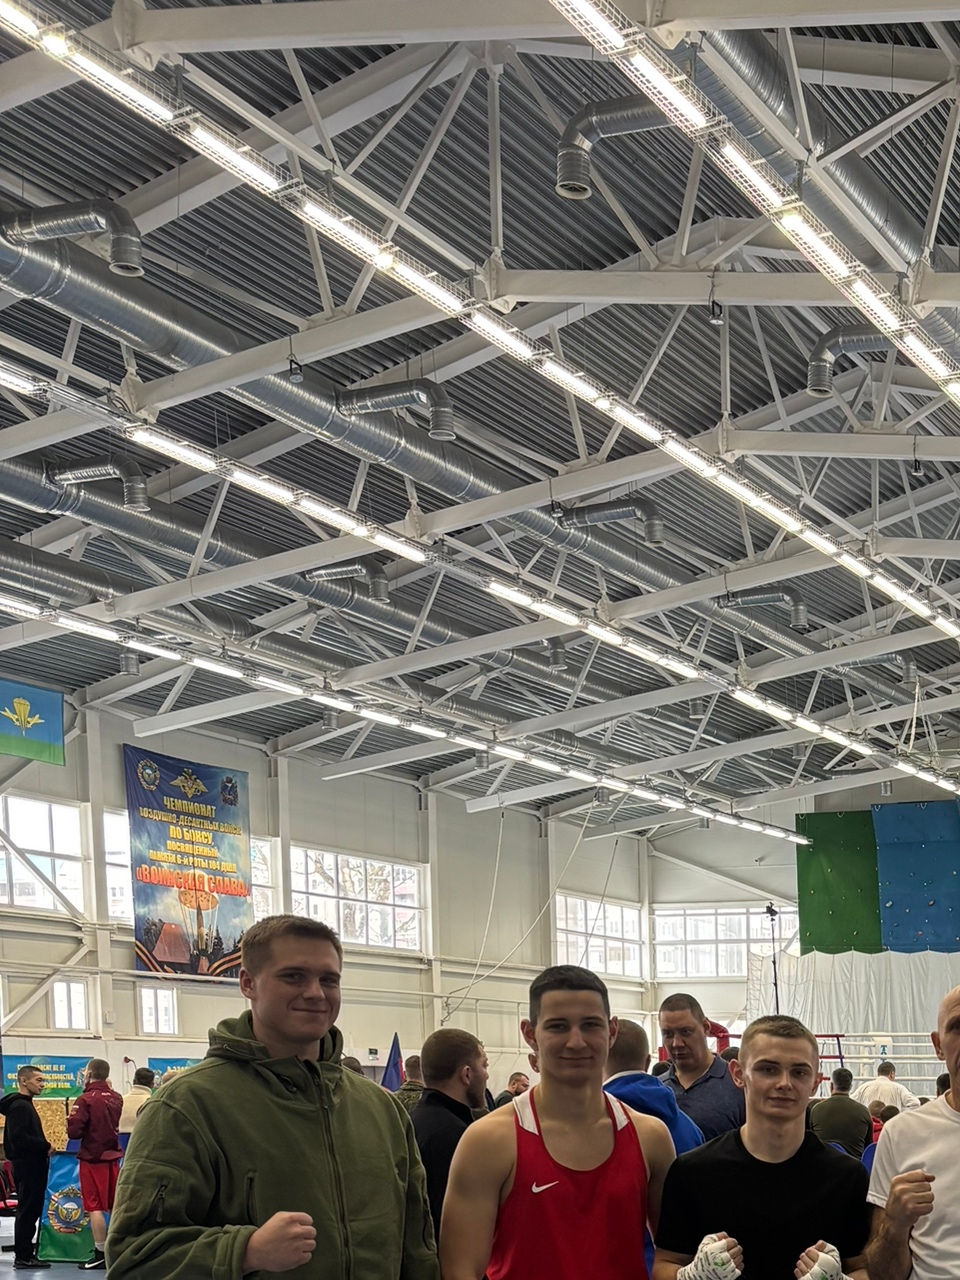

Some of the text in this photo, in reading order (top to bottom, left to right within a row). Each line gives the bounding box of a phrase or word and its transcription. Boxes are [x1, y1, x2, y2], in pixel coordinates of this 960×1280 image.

[163, 796, 216, 818] ЧЕМПИОНАТ
[169, 825, 181, 839] ПО
[189, 856, 208, 869] РОТЫ
